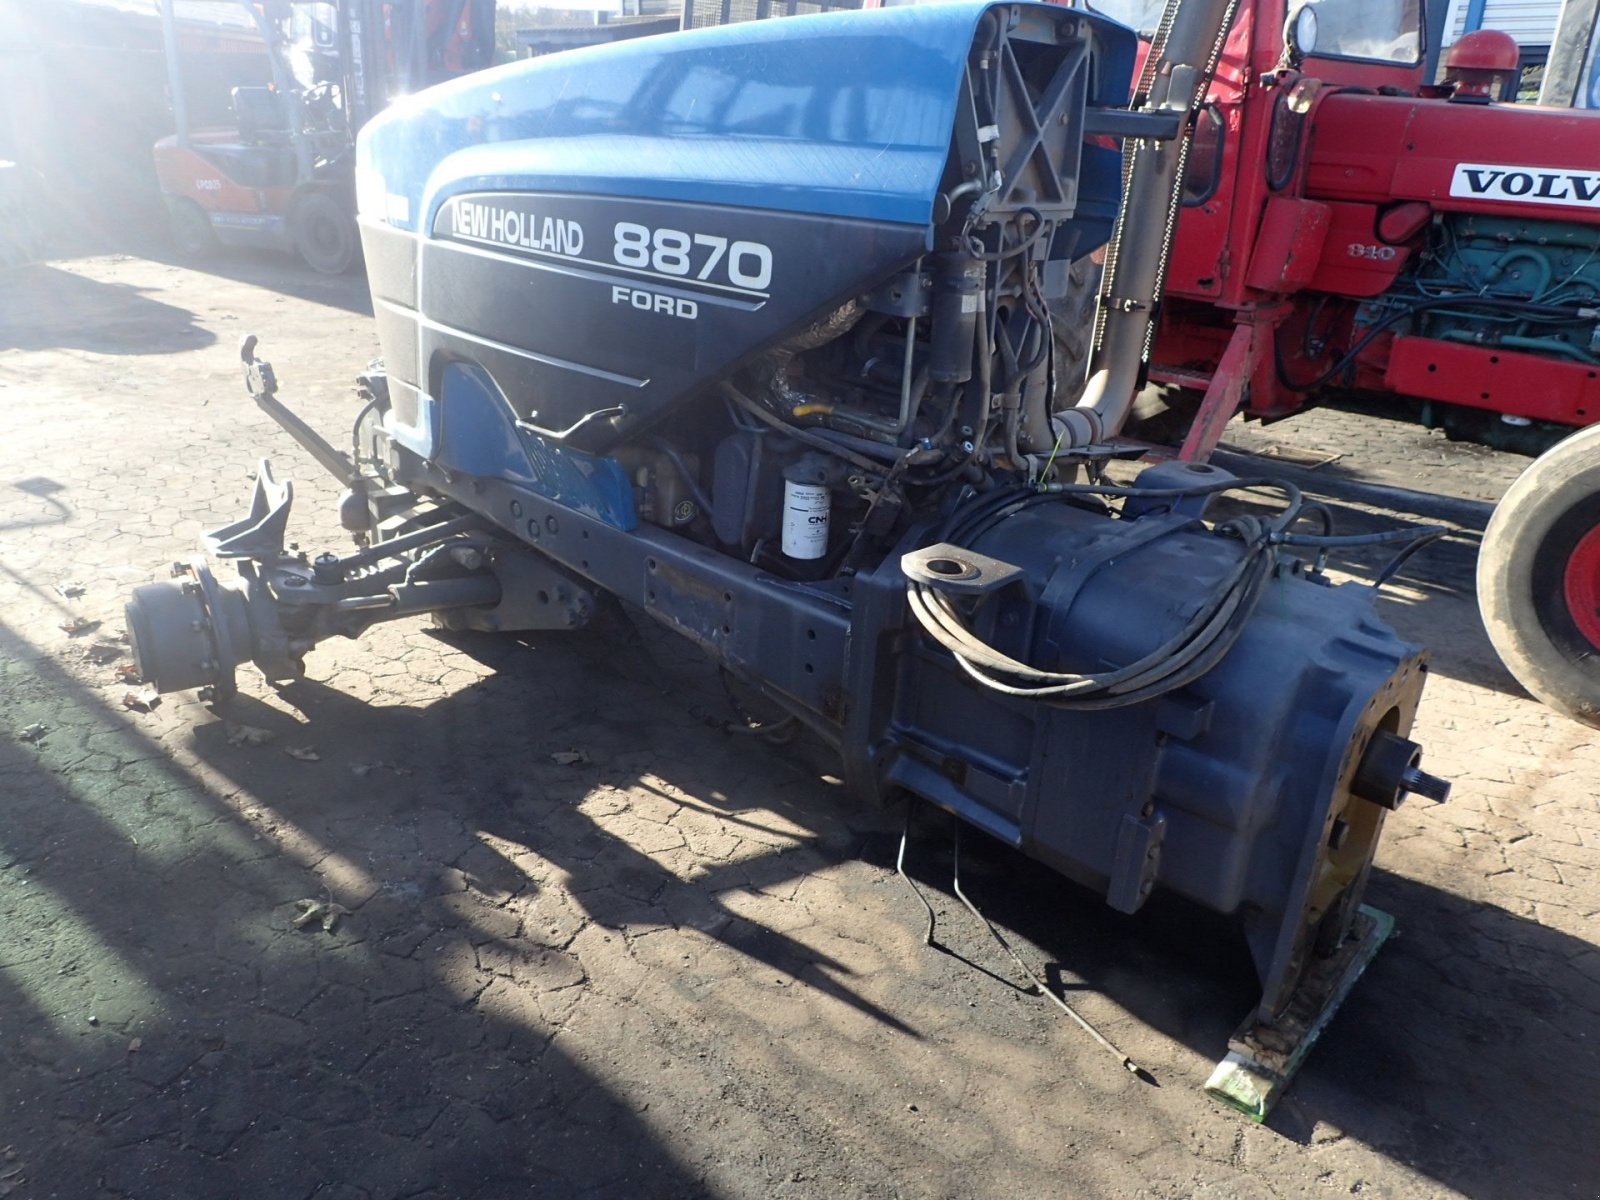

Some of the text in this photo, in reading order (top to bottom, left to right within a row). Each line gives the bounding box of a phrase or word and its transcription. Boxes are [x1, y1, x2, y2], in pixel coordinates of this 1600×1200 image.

[452, 202, 584, 256] NEW HOLLAND
[613, 221, 773, 290] 8870
[1347, 243, 1396, 261] 810
[612, 285, 698, 320] FORD
